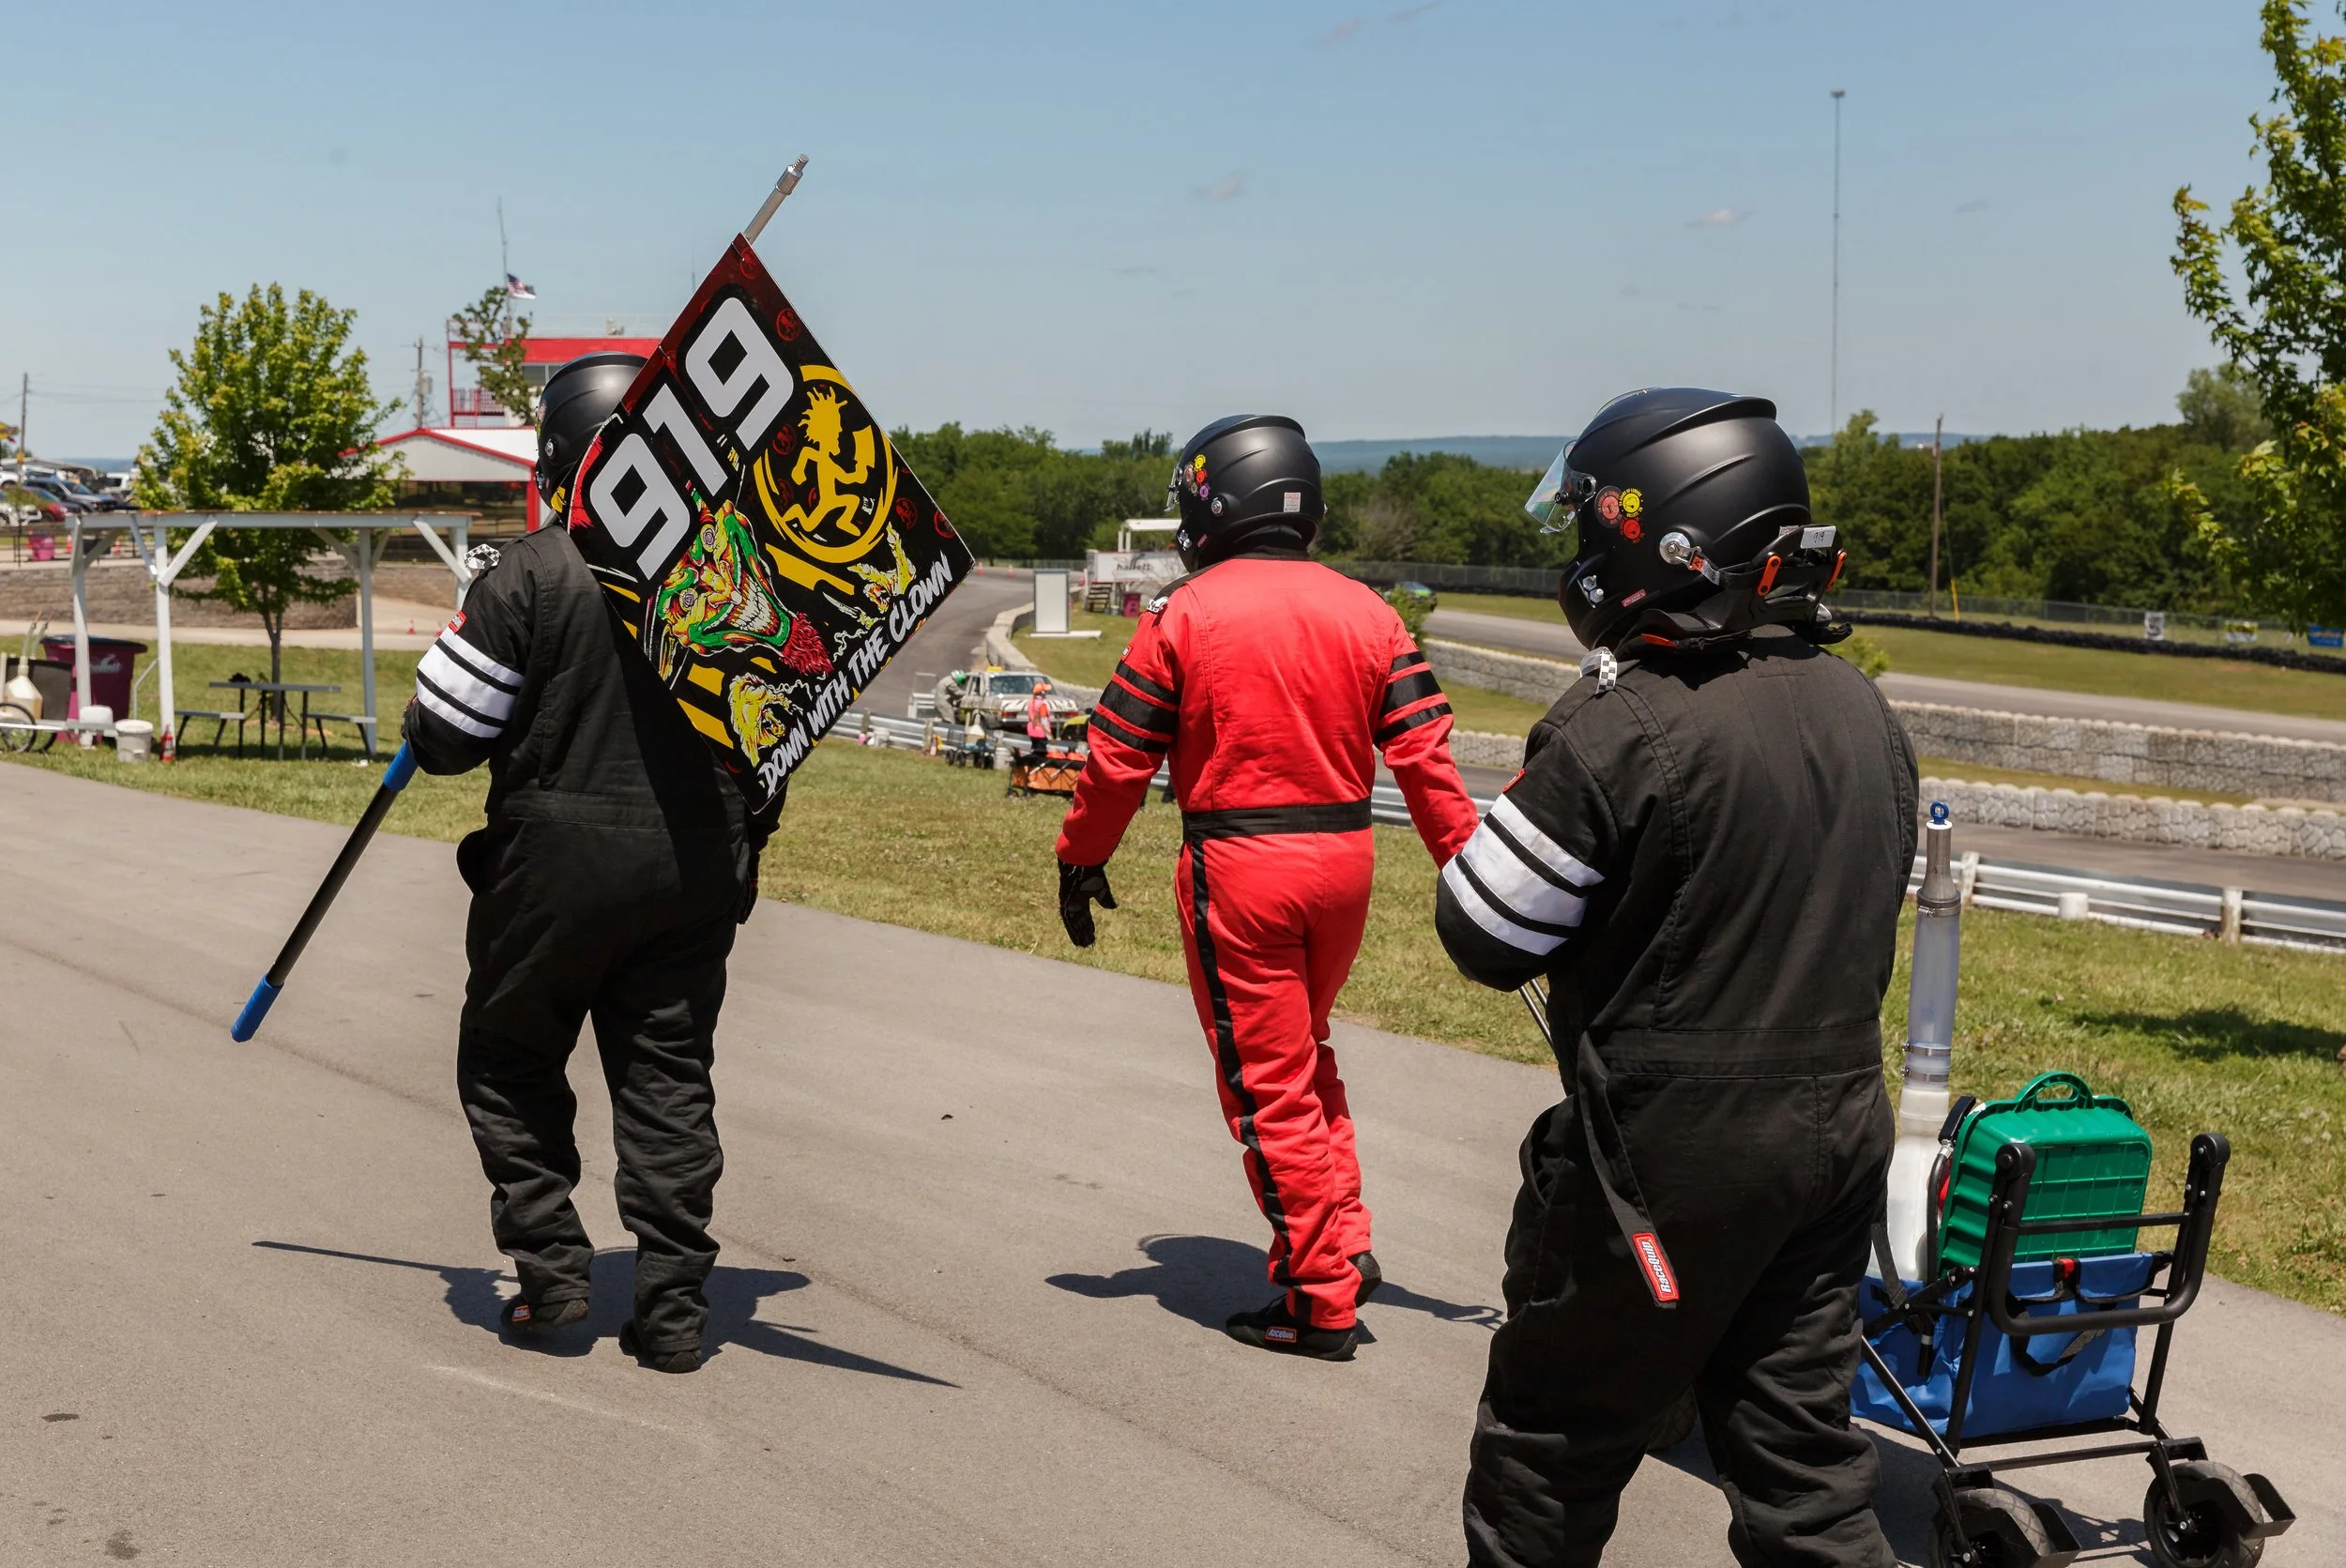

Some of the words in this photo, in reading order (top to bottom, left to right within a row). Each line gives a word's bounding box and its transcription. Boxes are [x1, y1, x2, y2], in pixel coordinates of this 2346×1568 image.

[590, 297, 794, 580] 919
[757, 719, 810, 799] DOWN
[848, 626, 890, 687] THE
[889, 551, 952, 642] CLOWN
